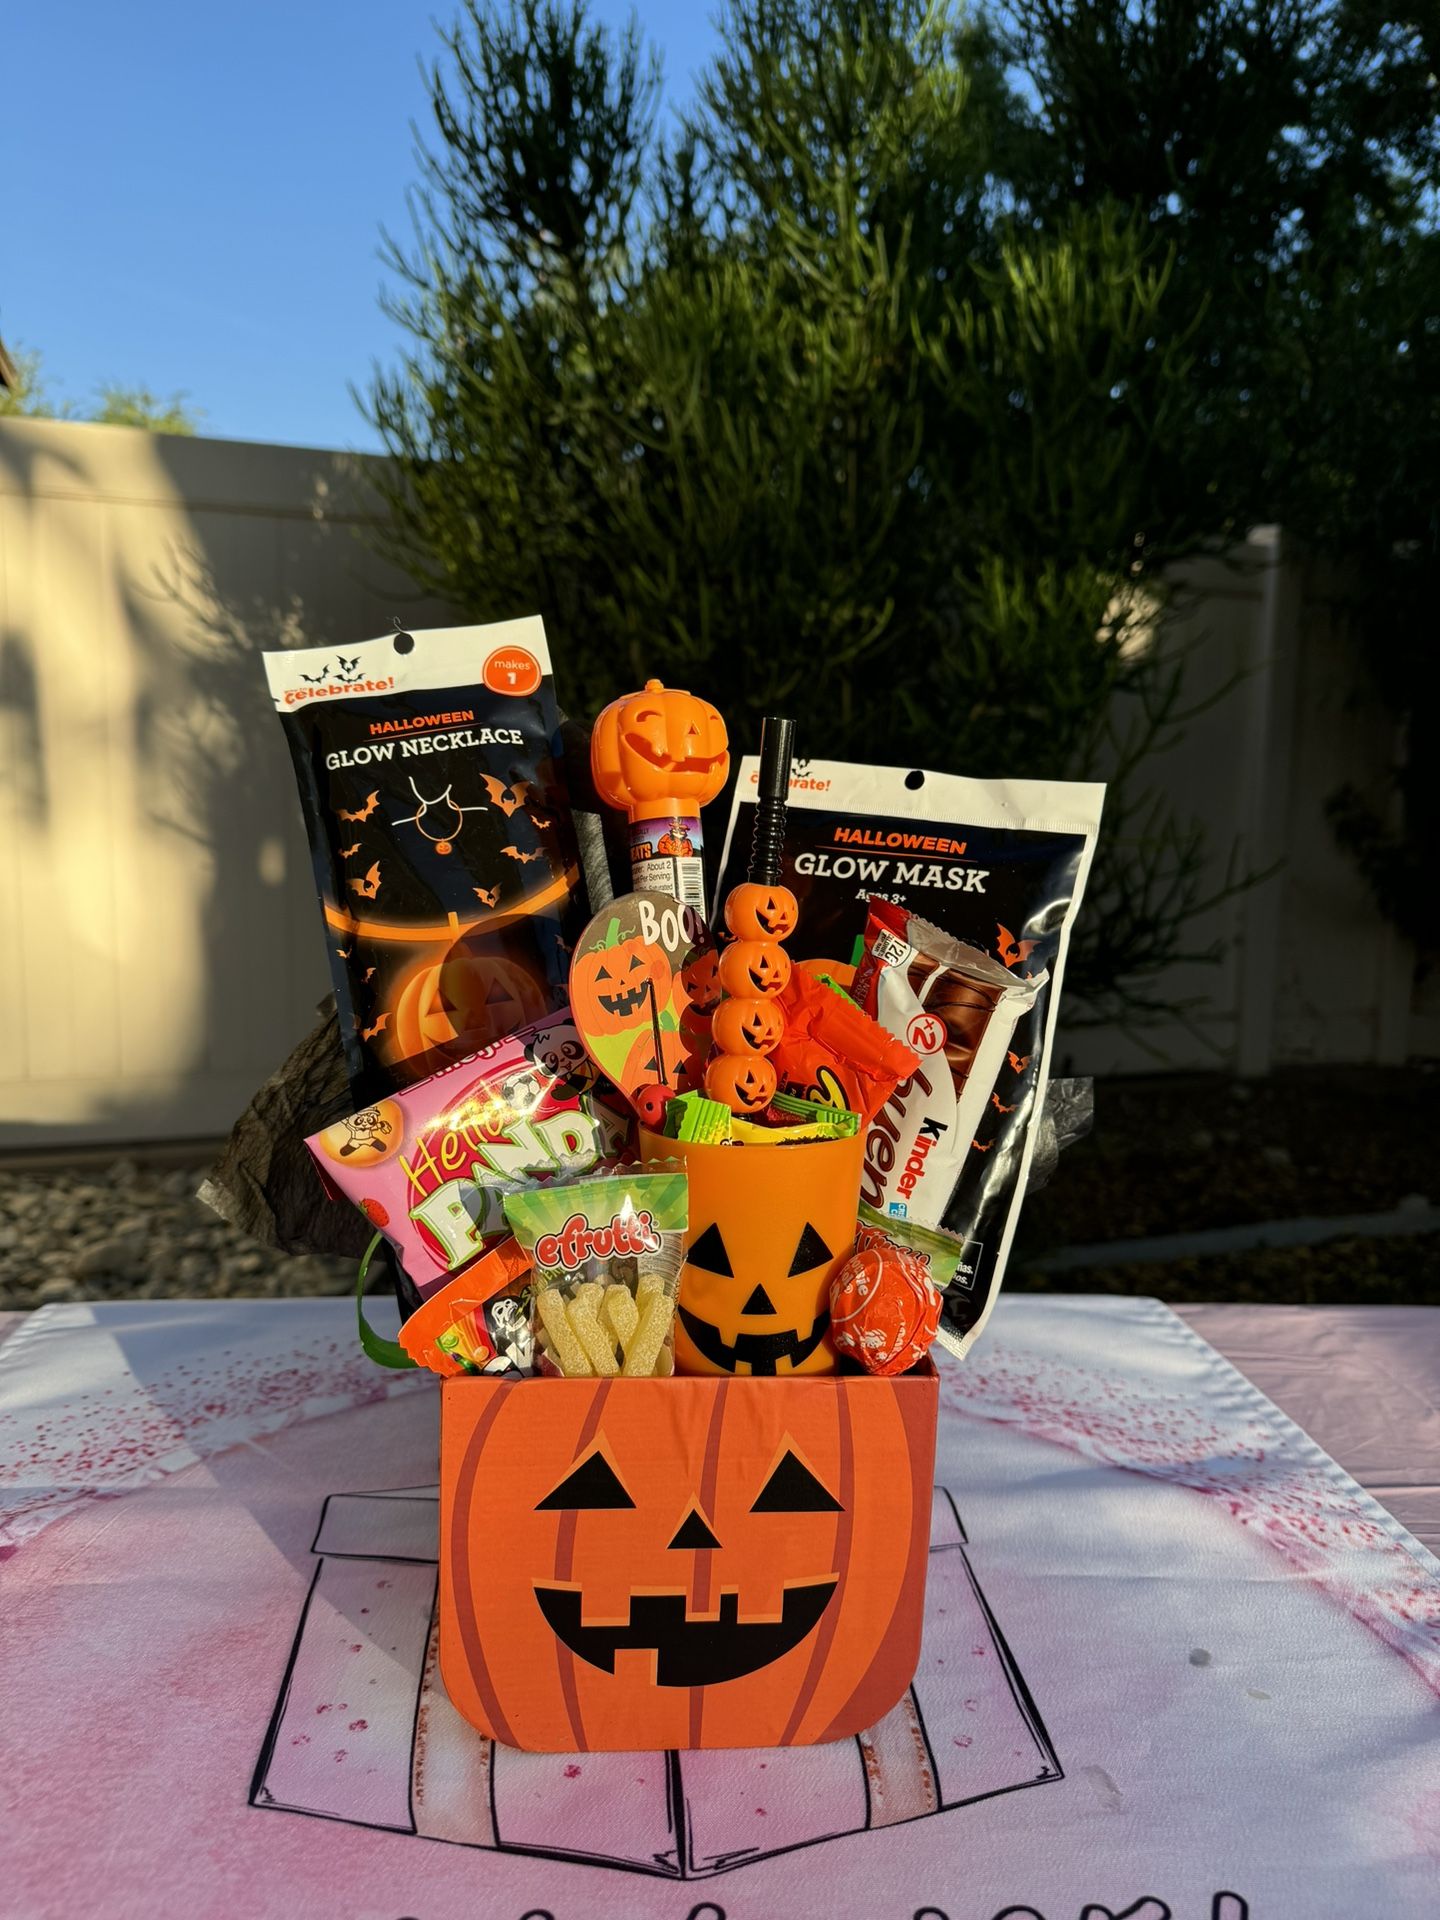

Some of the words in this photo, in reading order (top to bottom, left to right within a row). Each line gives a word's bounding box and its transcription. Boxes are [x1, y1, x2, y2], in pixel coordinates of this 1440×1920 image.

[494, 659, 531, 671] makes
[506, 671, 517, 685] 1
[284, 676, 395, 704] celebrate!
[369, 710, 475, 735] HALLOWEEN
[325, 742, 396, 770] GLOW
[401, 729, 524, 758] NECKLACE
[750, 773, 832, 792] crate!
[833, 827, 968, 855] HALLOWEEN
[647, 862, 665, 871] About
[794, 852, 890, 881] GLOW
[893, 862, 991, 894] MASK
[399, 1108, 505, 1197] Hello
[408, 1107, 631, 1271] PANDA
[534, 1210, 665, 1270] efrutti
